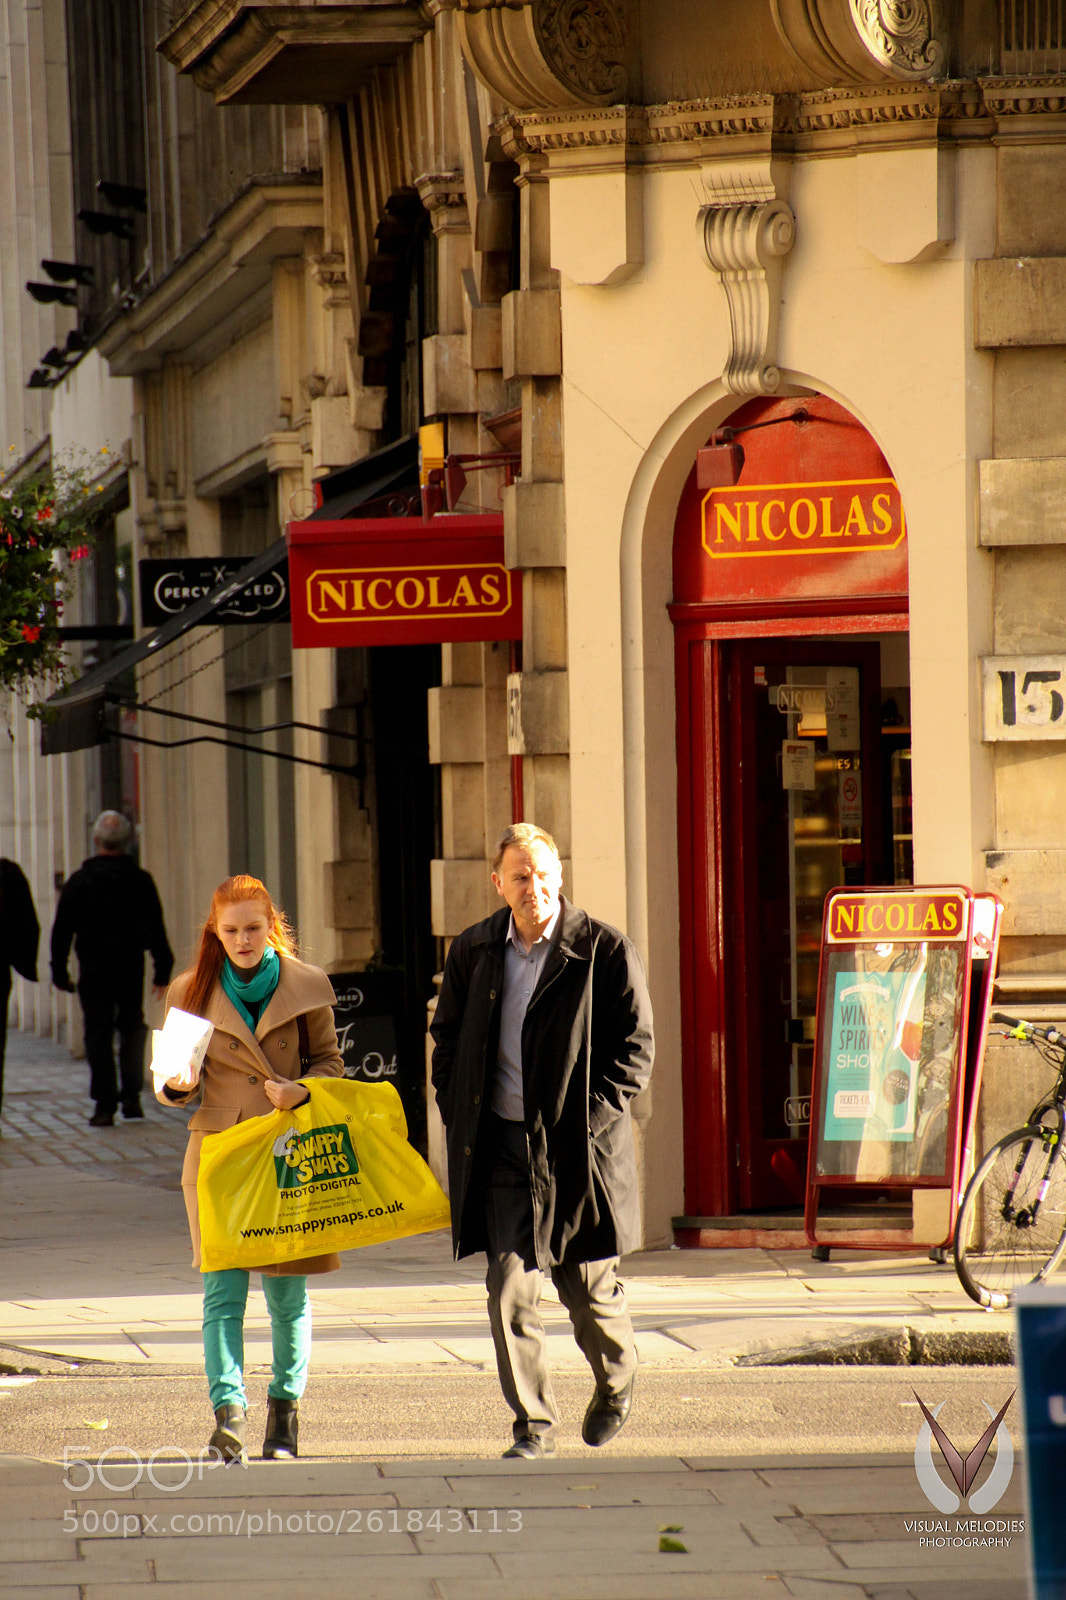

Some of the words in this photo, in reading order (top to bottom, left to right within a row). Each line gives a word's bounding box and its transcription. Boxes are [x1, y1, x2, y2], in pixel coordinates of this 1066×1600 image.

[713, 493, 893, 544] NICOLAS
[164, 586, 210, 599] PERCY
[317, 574, 501, 612] NICOLAS
[780, 690, 835, 709] NICOS
[997, 671, 1064, 727] 15
[835, 902, 958, 934] NICOLAS
[841, 1005, 875, 1027] WINE
[838, 1029, 885, 1051] SPIRITS
[362, 1051, 398, 1078] Out
[836, 1053, 883, 1069] SHOW
[285, 1130, 344, 1168] SNAPPY
[296, 1153, 350, 1183] SNAPS
[240, 1200, 404, 1238] www.snappysnaps.co.uk
